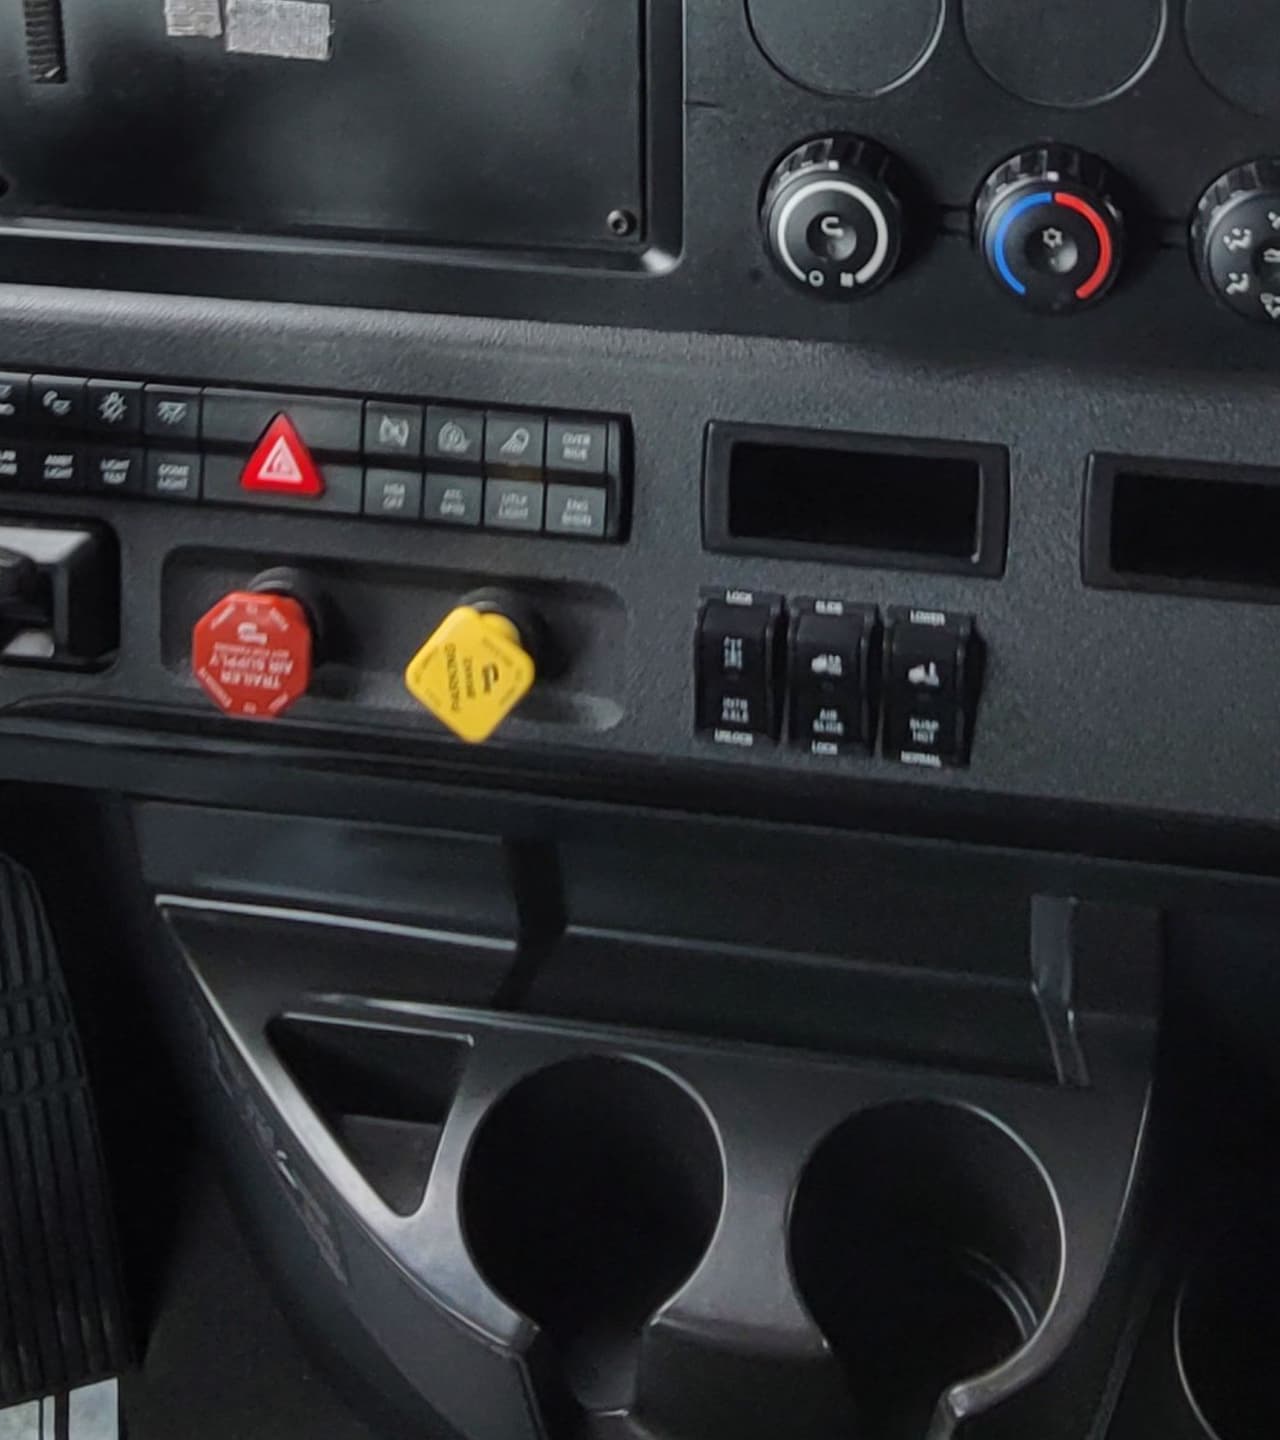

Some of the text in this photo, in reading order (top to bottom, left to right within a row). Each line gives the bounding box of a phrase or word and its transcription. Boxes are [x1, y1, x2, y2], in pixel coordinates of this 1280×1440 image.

[208, 651, 294, 674] AIR SUPPLY
[220, 669, 282, 689] TRAILER
